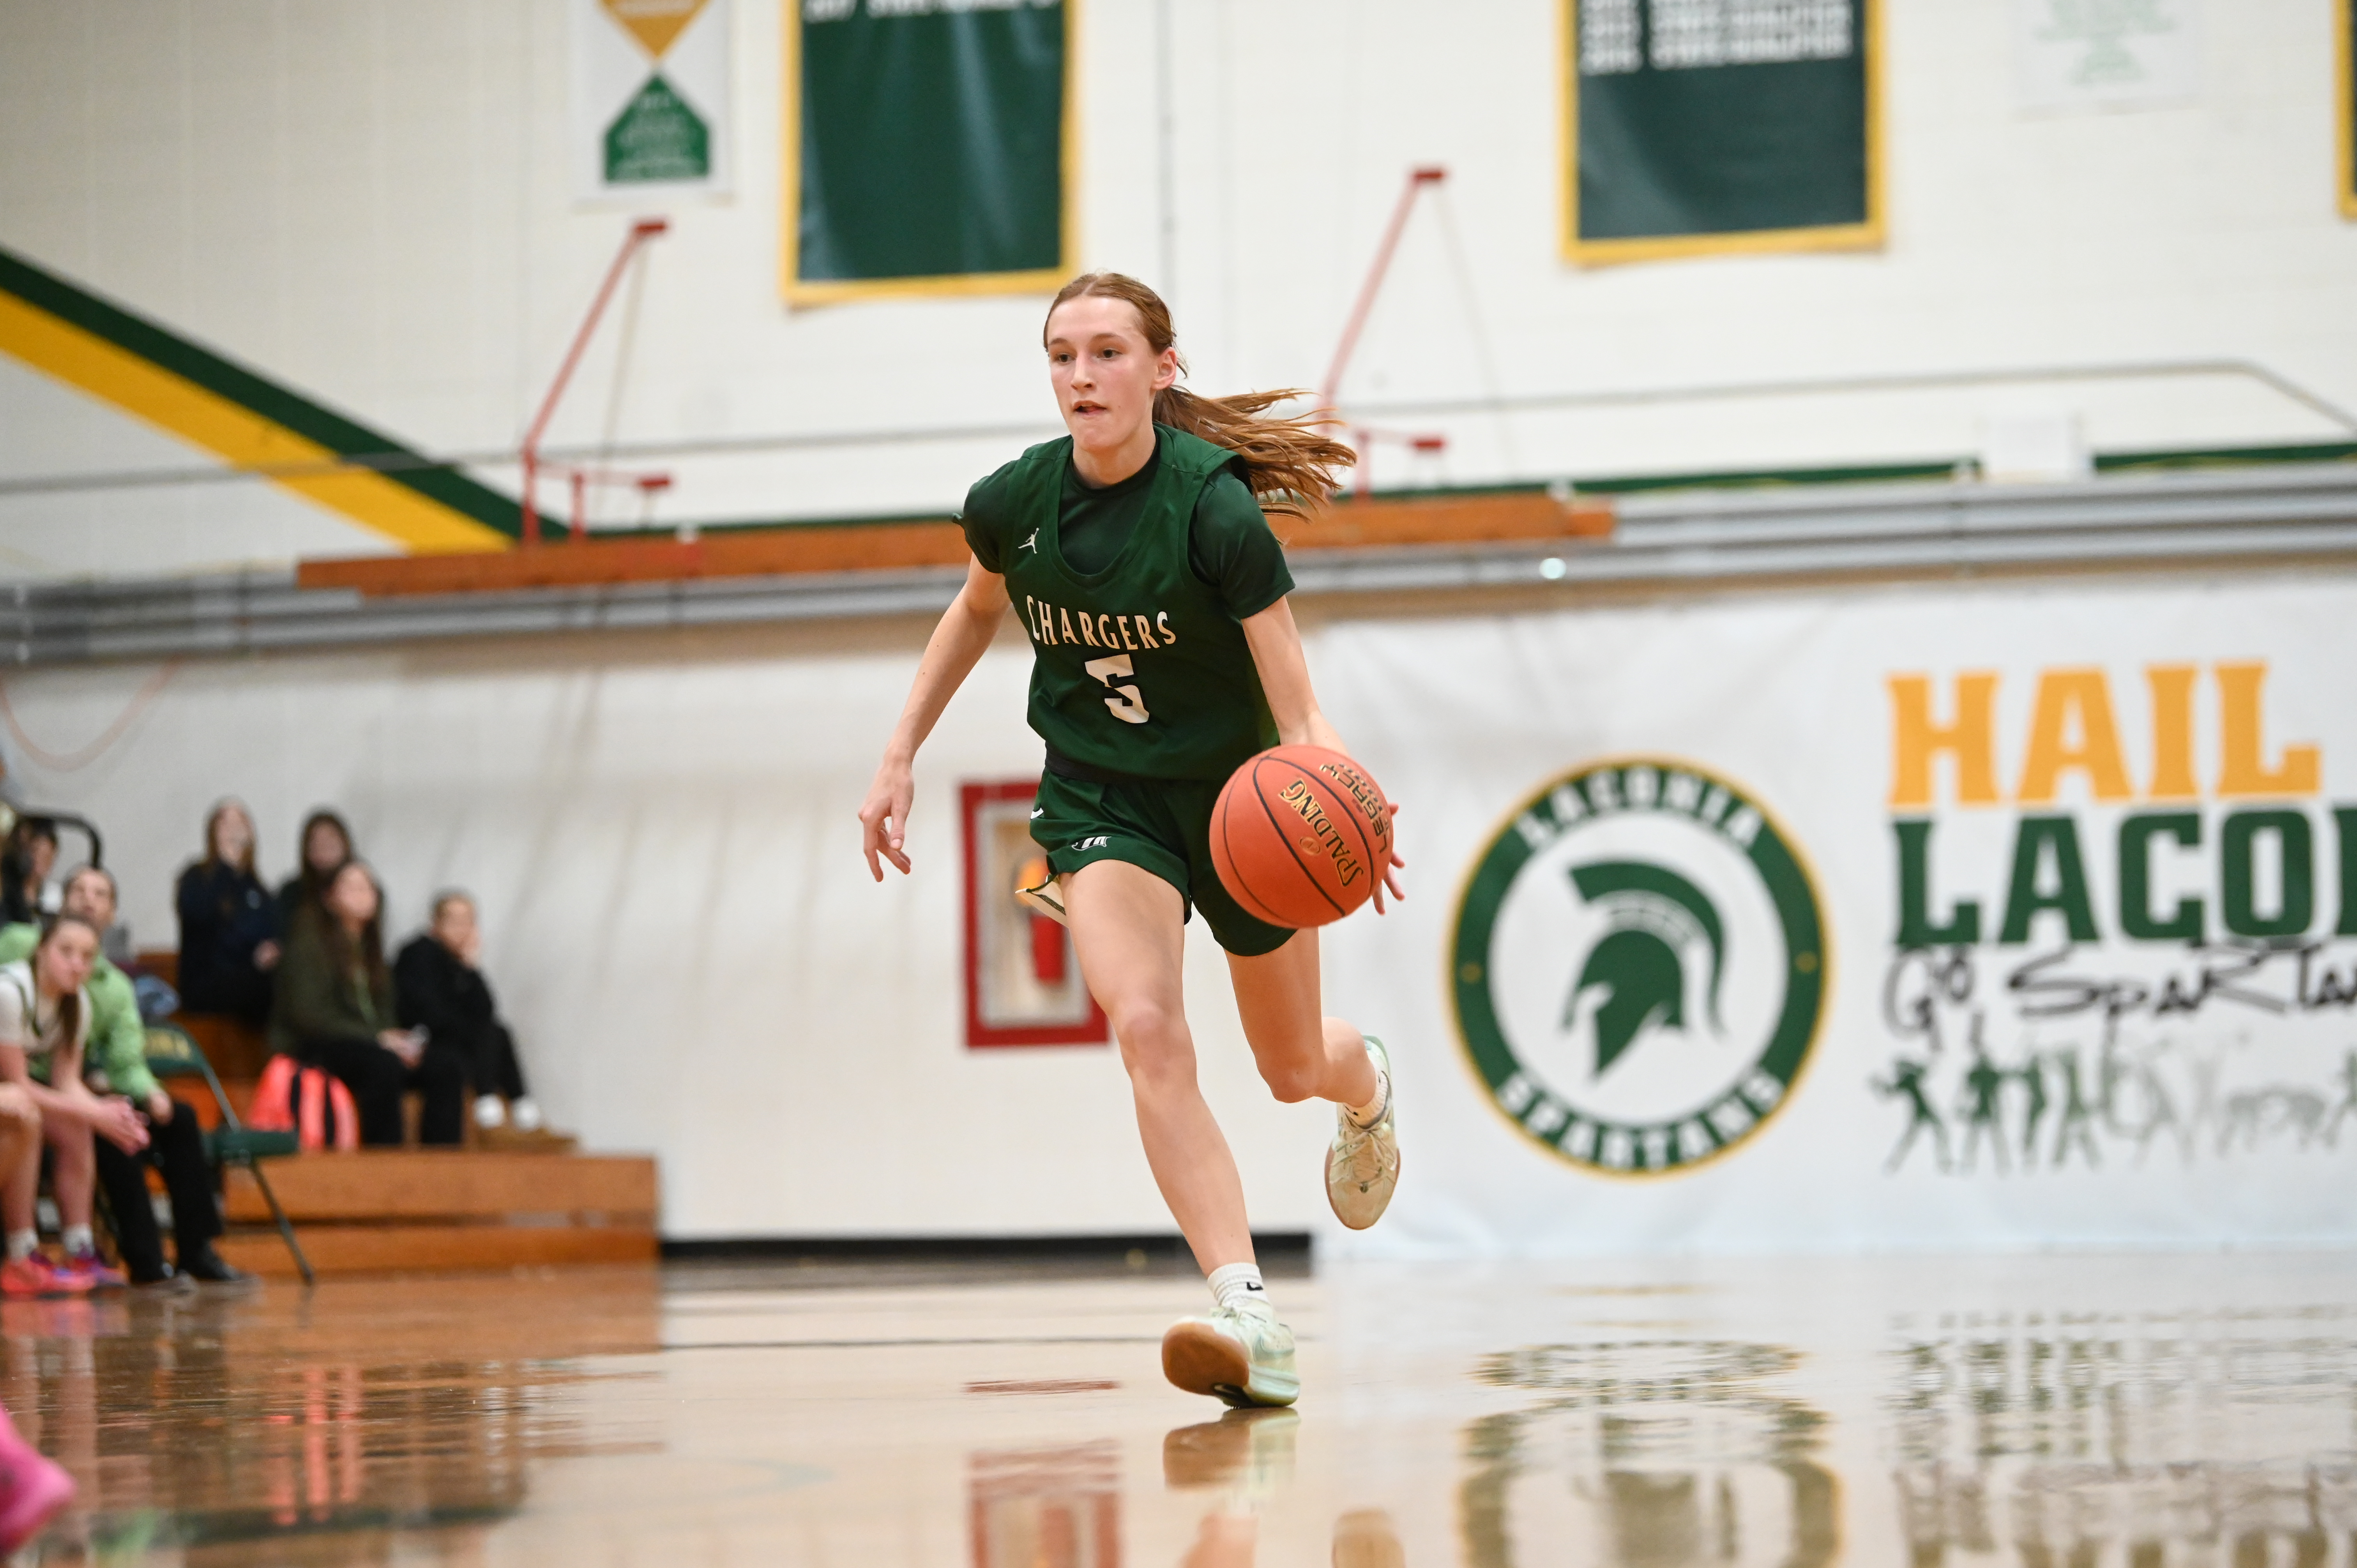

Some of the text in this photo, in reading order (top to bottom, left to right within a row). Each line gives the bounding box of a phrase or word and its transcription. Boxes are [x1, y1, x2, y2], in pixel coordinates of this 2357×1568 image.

[1026, 595, 1177, 650] CHARGERS
[1084, 653, 1150, 724] 5
[1885, 659, 2322, 810] HAIL
[1278, 778, 1364, 887] SPALDING
[1319, 764, 1387, 854] LEGACY
[1514, 766, 1762, 854] LACONIA
[1891, 804, 2357, 948] LACO
[1495, 1067, 1786, 1171] SPARTANS
